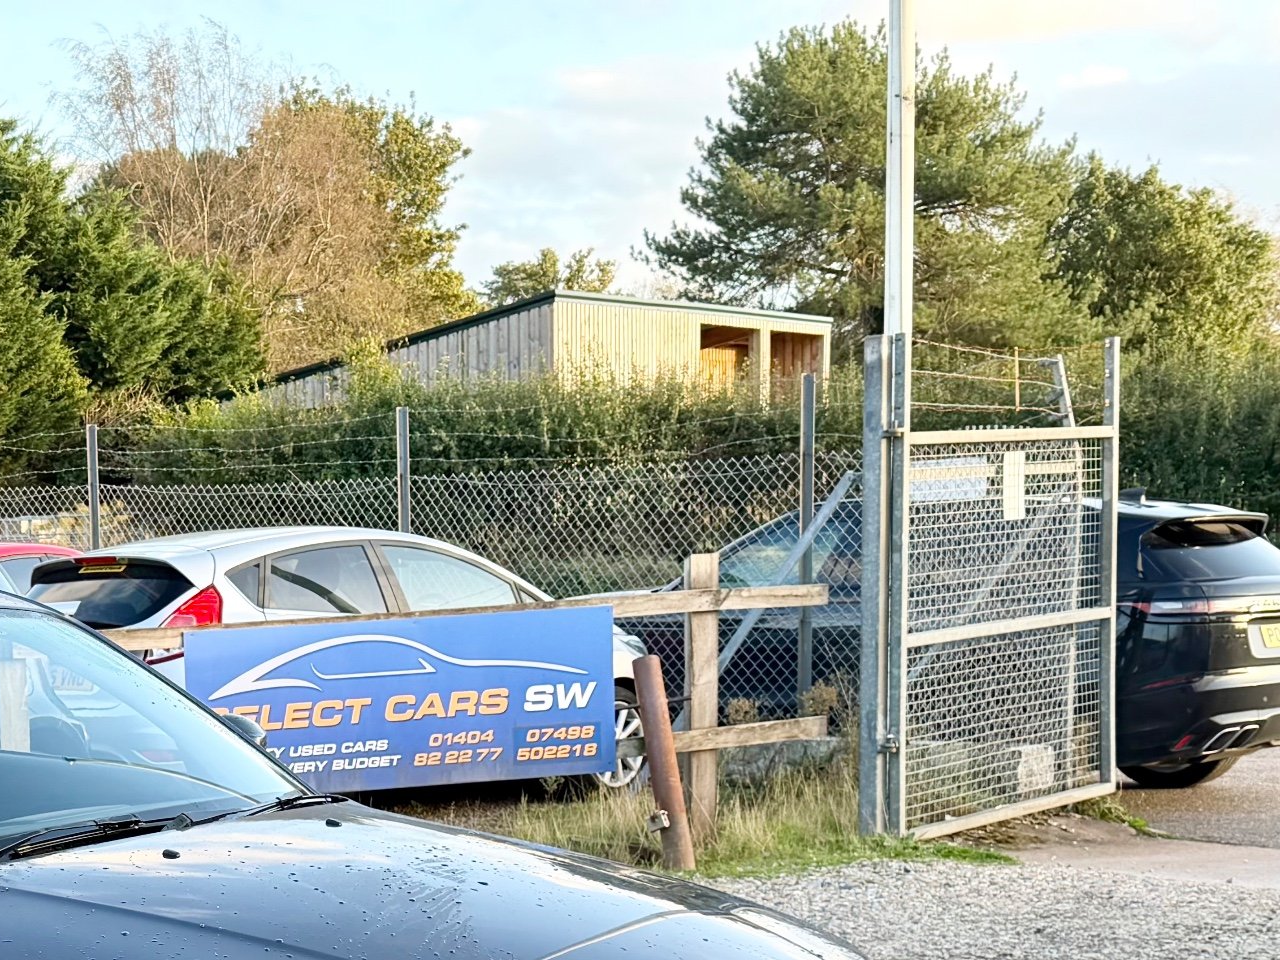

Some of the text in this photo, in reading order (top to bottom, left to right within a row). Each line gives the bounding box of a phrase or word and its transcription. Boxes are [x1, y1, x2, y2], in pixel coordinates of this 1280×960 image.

[385, 687, 509, 723] CARS
[524, 681, 597, 712] SW
[429, 729, 495, 747] 01404
[526, 725, 595, 743] 07498
[289, 743, 337, 758] USED
[341, 739, 388, 754] CARS
[517, 743, 598, 761] 502218
[332, 755, 402, 771] BUDGET
